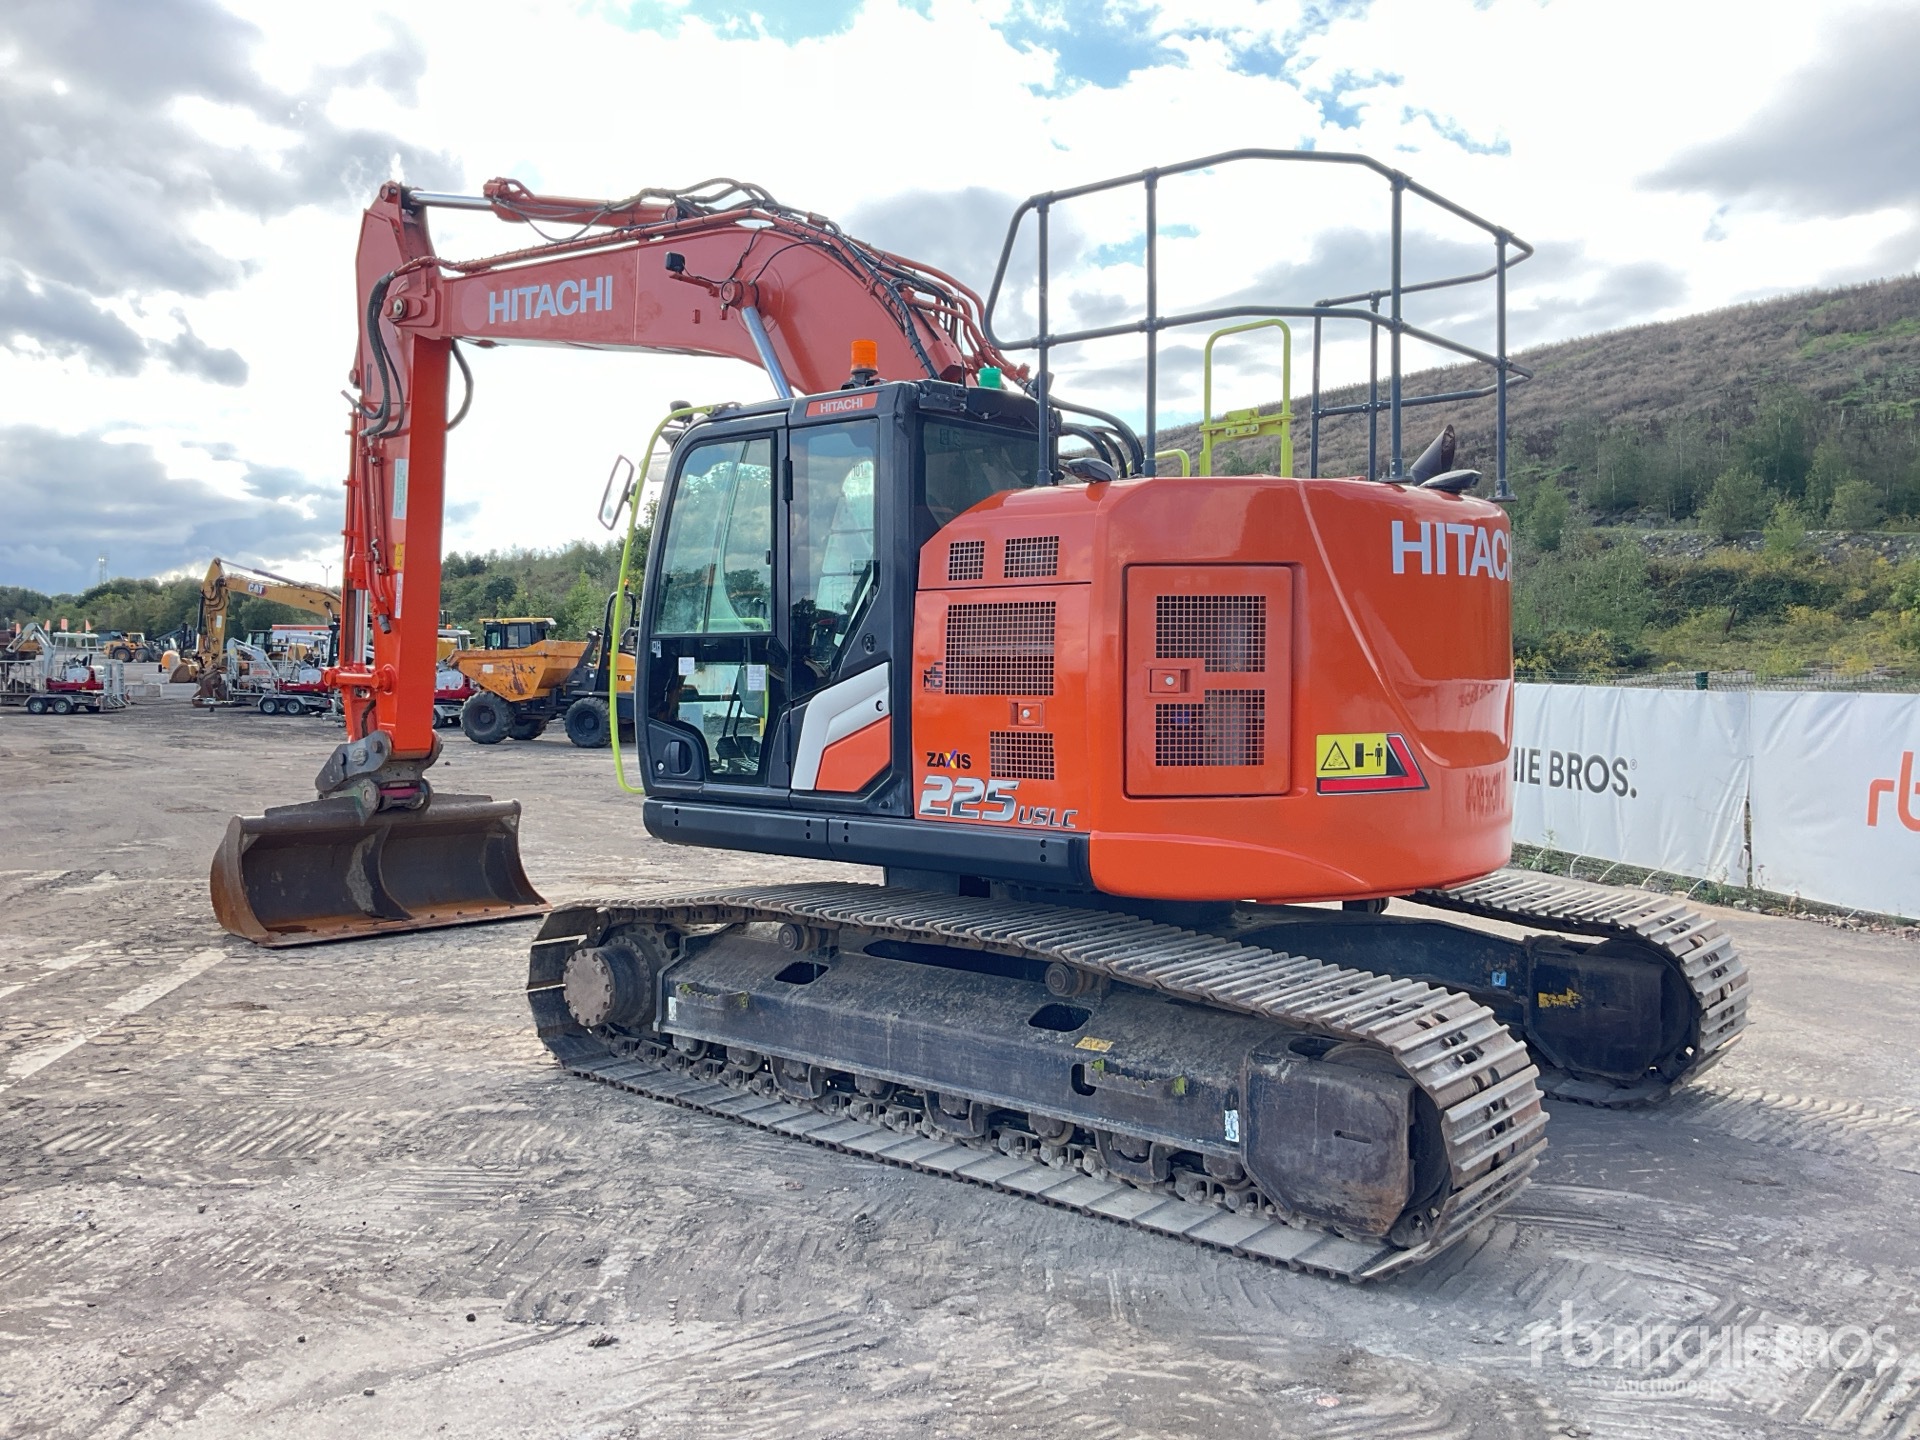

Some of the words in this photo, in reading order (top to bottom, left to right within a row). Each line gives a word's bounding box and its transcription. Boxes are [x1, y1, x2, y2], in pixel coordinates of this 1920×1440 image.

[489, 275, 613, 324] HITACHI
[820, 398, 863, 413] HITACHI
[926, 750, 972, 769] ZAXIS
[919, 775, 1020, 822] 225
[1018, 805, 1078, 828] USLC
